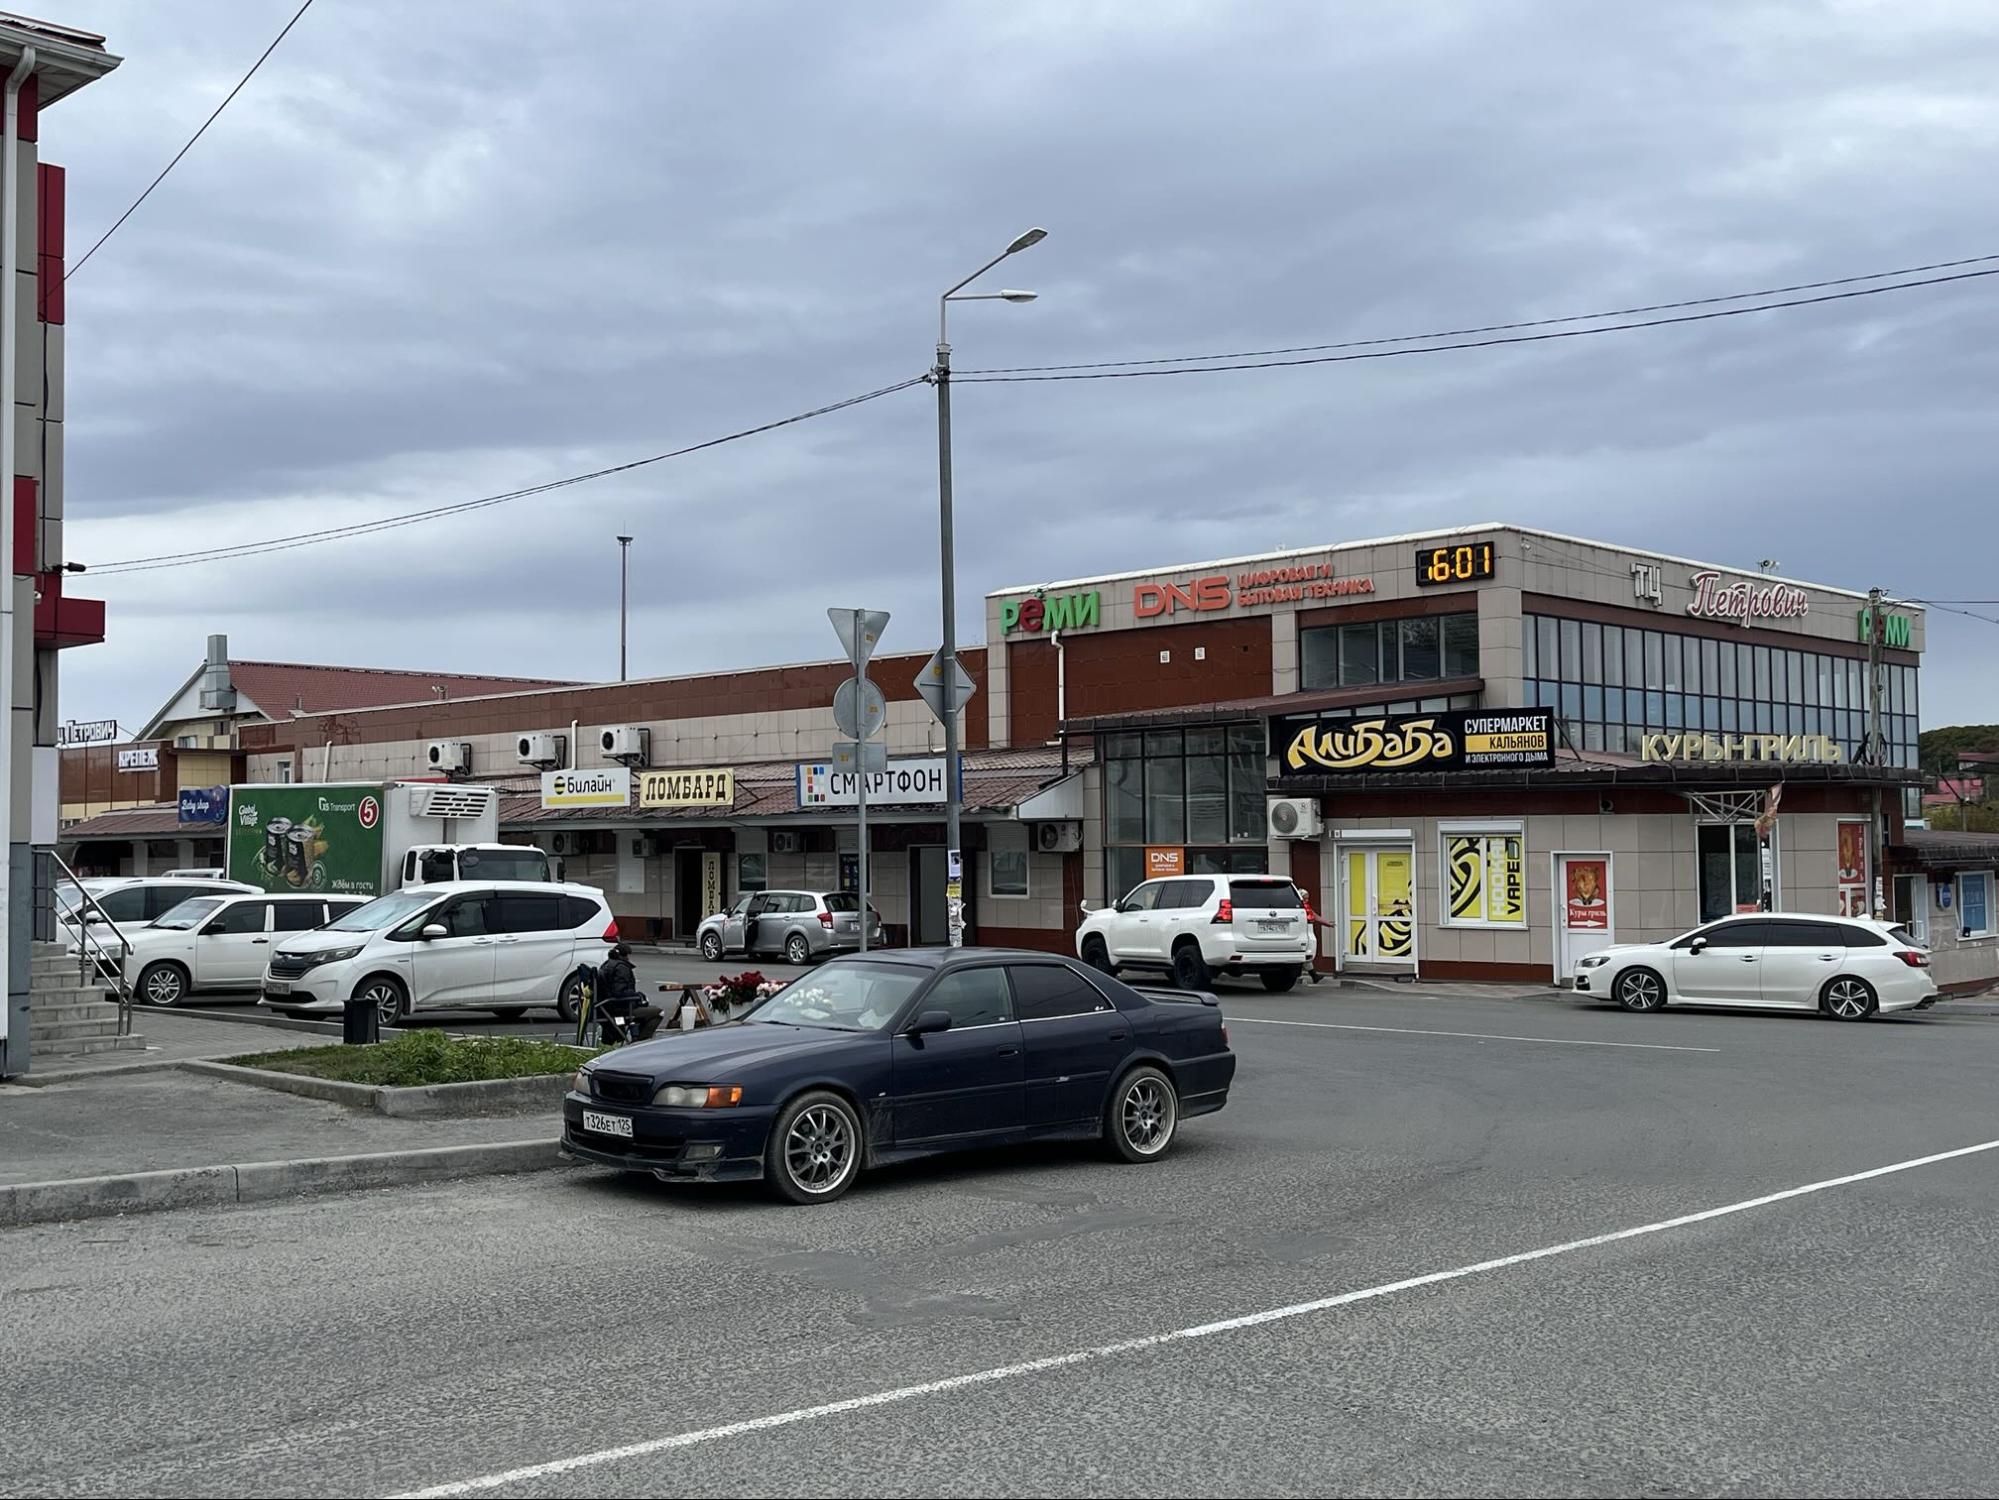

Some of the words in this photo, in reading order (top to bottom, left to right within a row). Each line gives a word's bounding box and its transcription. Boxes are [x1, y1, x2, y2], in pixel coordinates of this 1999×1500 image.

[1237, 564, 1317, 589] ЦИФРОВАЯ
[1134, 574, 1232, 619] DNS
[1237, 583, 1304, 607] БЫТОВАЯ
[1308, 578, 1375, 599] ТЕХНИКА
[1631, 562, 1663, 608] ТЦ
[1686, 570, 1809, 628] Петрович
[1464, 715, 1548, 735] СУПЕРМАРКЕТ
[1489, 736, 1545, 751] КАЛЬЯНОВ
[1641, 734, 1842, 761] КУРЫ-ГРИЛЬ
[118, 748, 159, 767] КРЕПЕЖ
[1465, 754, 1471, 764] И
[1472, 752, 1524, 764] ЭЛЕКТРОННОГО
[1525, 751, 1549, 763] ДЫМА
[645, 774, 727, 801] ЛОМБАРД
[1150, 852, 1179, 863] DNS
[1507, 861, 1521, 915] VAPE
